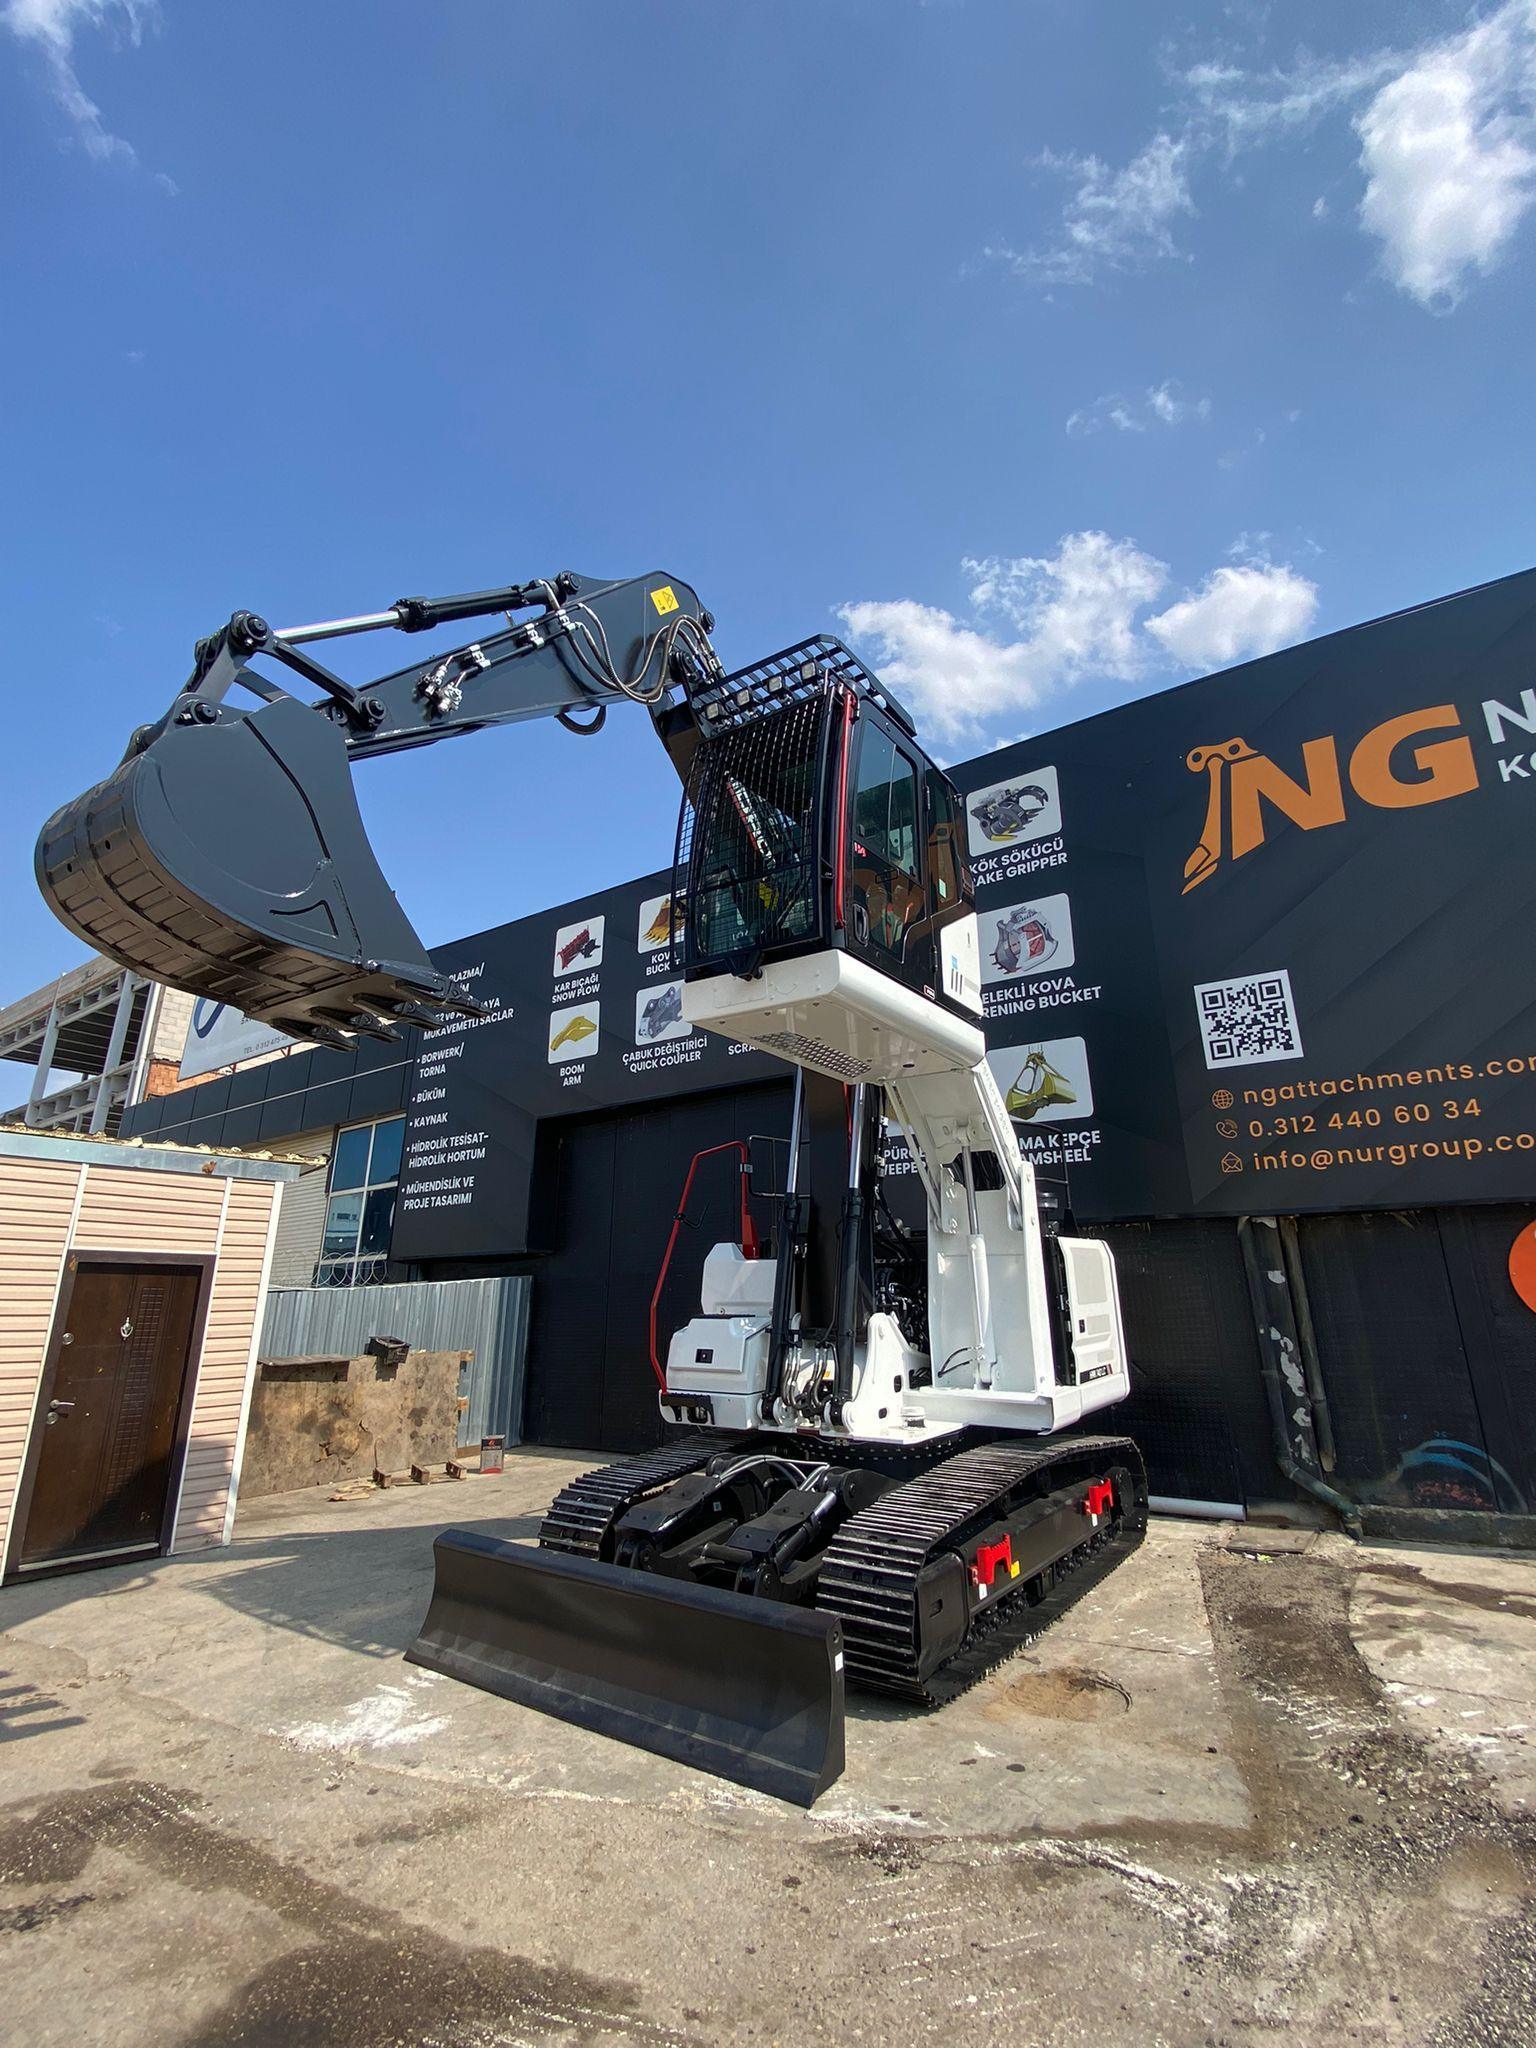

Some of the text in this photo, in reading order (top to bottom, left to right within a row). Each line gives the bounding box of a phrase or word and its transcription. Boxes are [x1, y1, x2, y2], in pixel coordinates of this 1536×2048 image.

[969, 837, 1064, 874] KÖK SÖKÜCÜ
[974, 853, 1068, 886] AKE GRIPPER
[646, 959, 680, 975] BUCKT
[552, 983, 600, 1003] SNOW PLOW
[554, 973, 599, 993] KAR BIÇAĞI
[981, 976, 1076, 1004] ELEKLİ KOVA
[1039, 986, 1101, 1009] BUCKET
[421, 1042, 465, 1064] BORWERK/
[622, 1035, 708, 1065] ÇABUK DEĞİŞTİRİCİ
[420, 1064, 446, 1078] TORNA
[560, 1064, 585, 1077] BOOM
[630, 1051, 701, 1073] QUICK COUPLER
[563, 1075, 582, 1087] ARM
[417, 1087, 446, 1103] BÜKÜM
[413, 1112, 449, 1128] KAYNAK
[1249, 1098, 1482, 1138] 0.312 440 60 34
[411, 1132, 489, 1153] HİDROLİK TESİSAT-
[1048, 1130, 1102, 1149] KEPÇE
[408, 1147, 486, 1169] HİDROLİK HORTUM
[406, 1176, 475, 1194] MÜHENDİSLİK VE
[403, 1192, 473, 1211] PROJE TASARIMI
